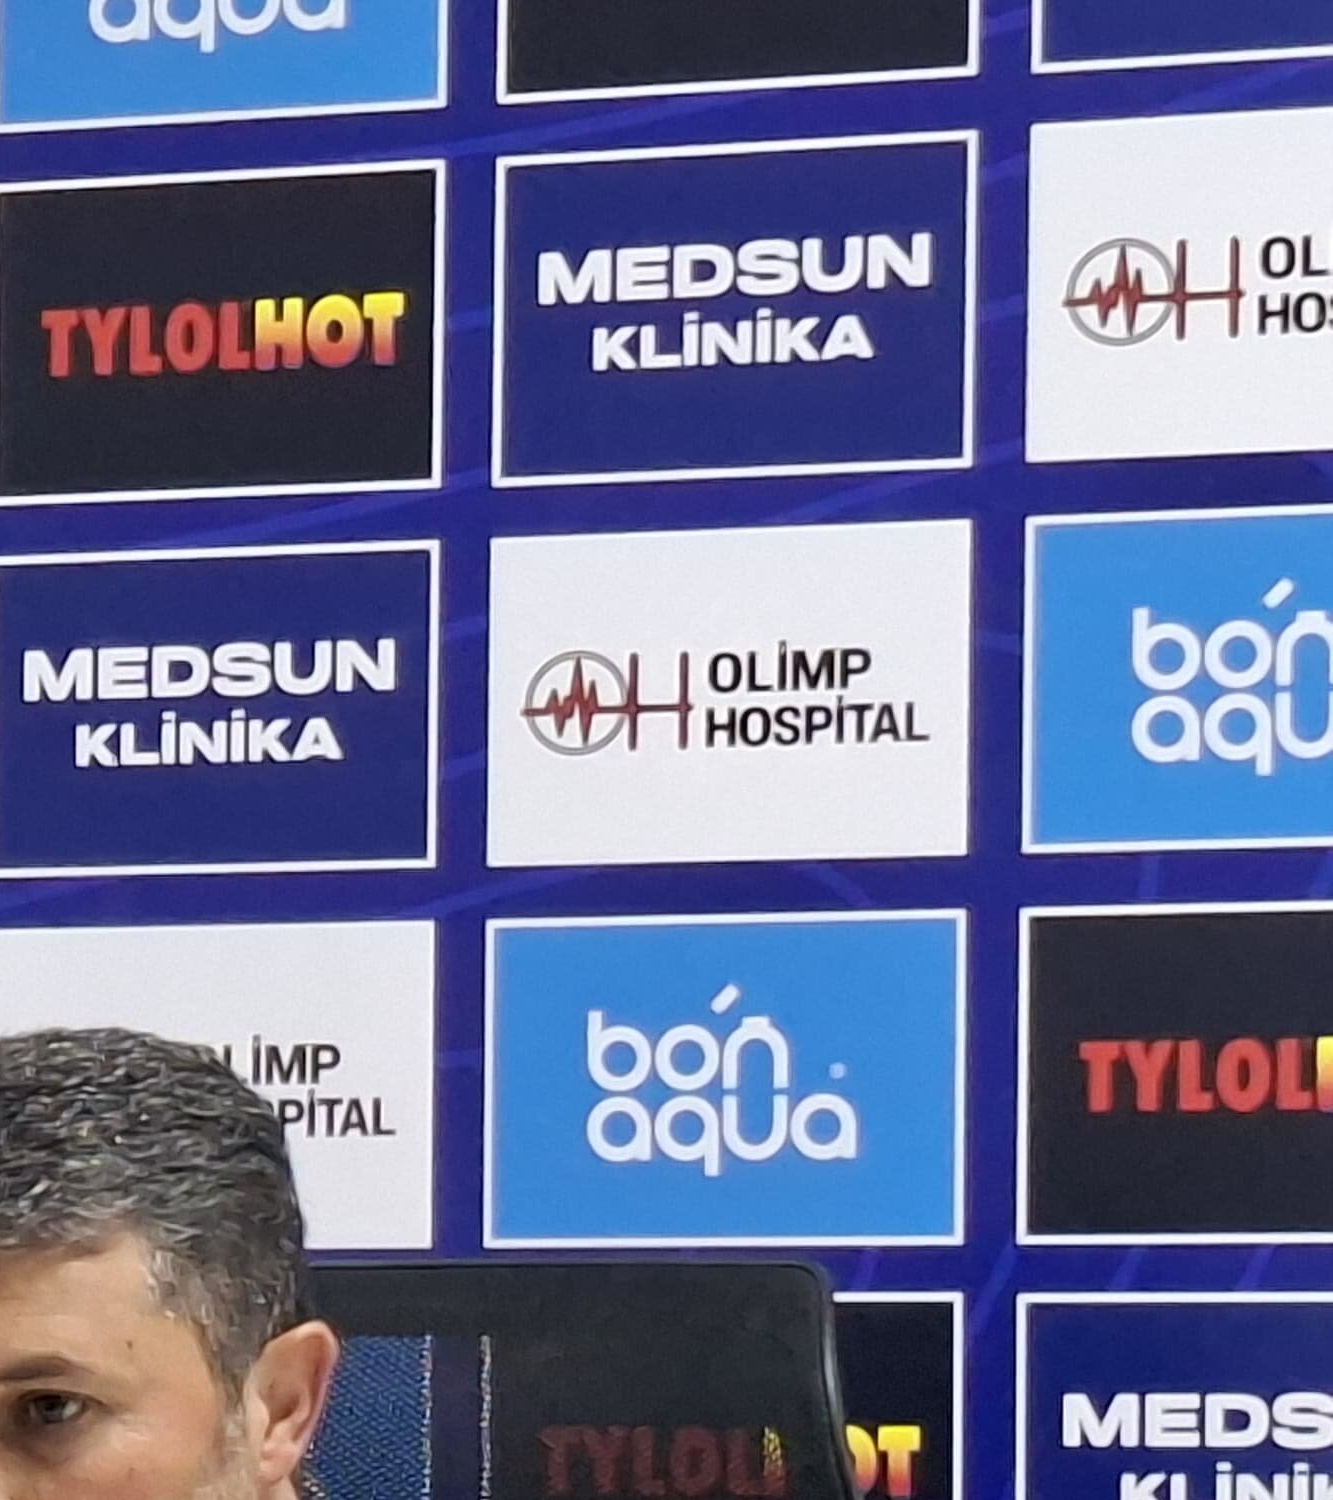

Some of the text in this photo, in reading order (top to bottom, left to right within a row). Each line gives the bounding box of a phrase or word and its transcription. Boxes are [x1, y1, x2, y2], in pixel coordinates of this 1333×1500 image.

[536, 232, 933, 305] MEDSUN
[23, 638, 396, 702] MEDSUN
[1131, 691, 1333, 777] aqu
[1079, 1035, 1333, 1113] TYLOL
[586, 1092, 858, 1177] aqua
[1062, 1391, 1333, 1450] MEDS
